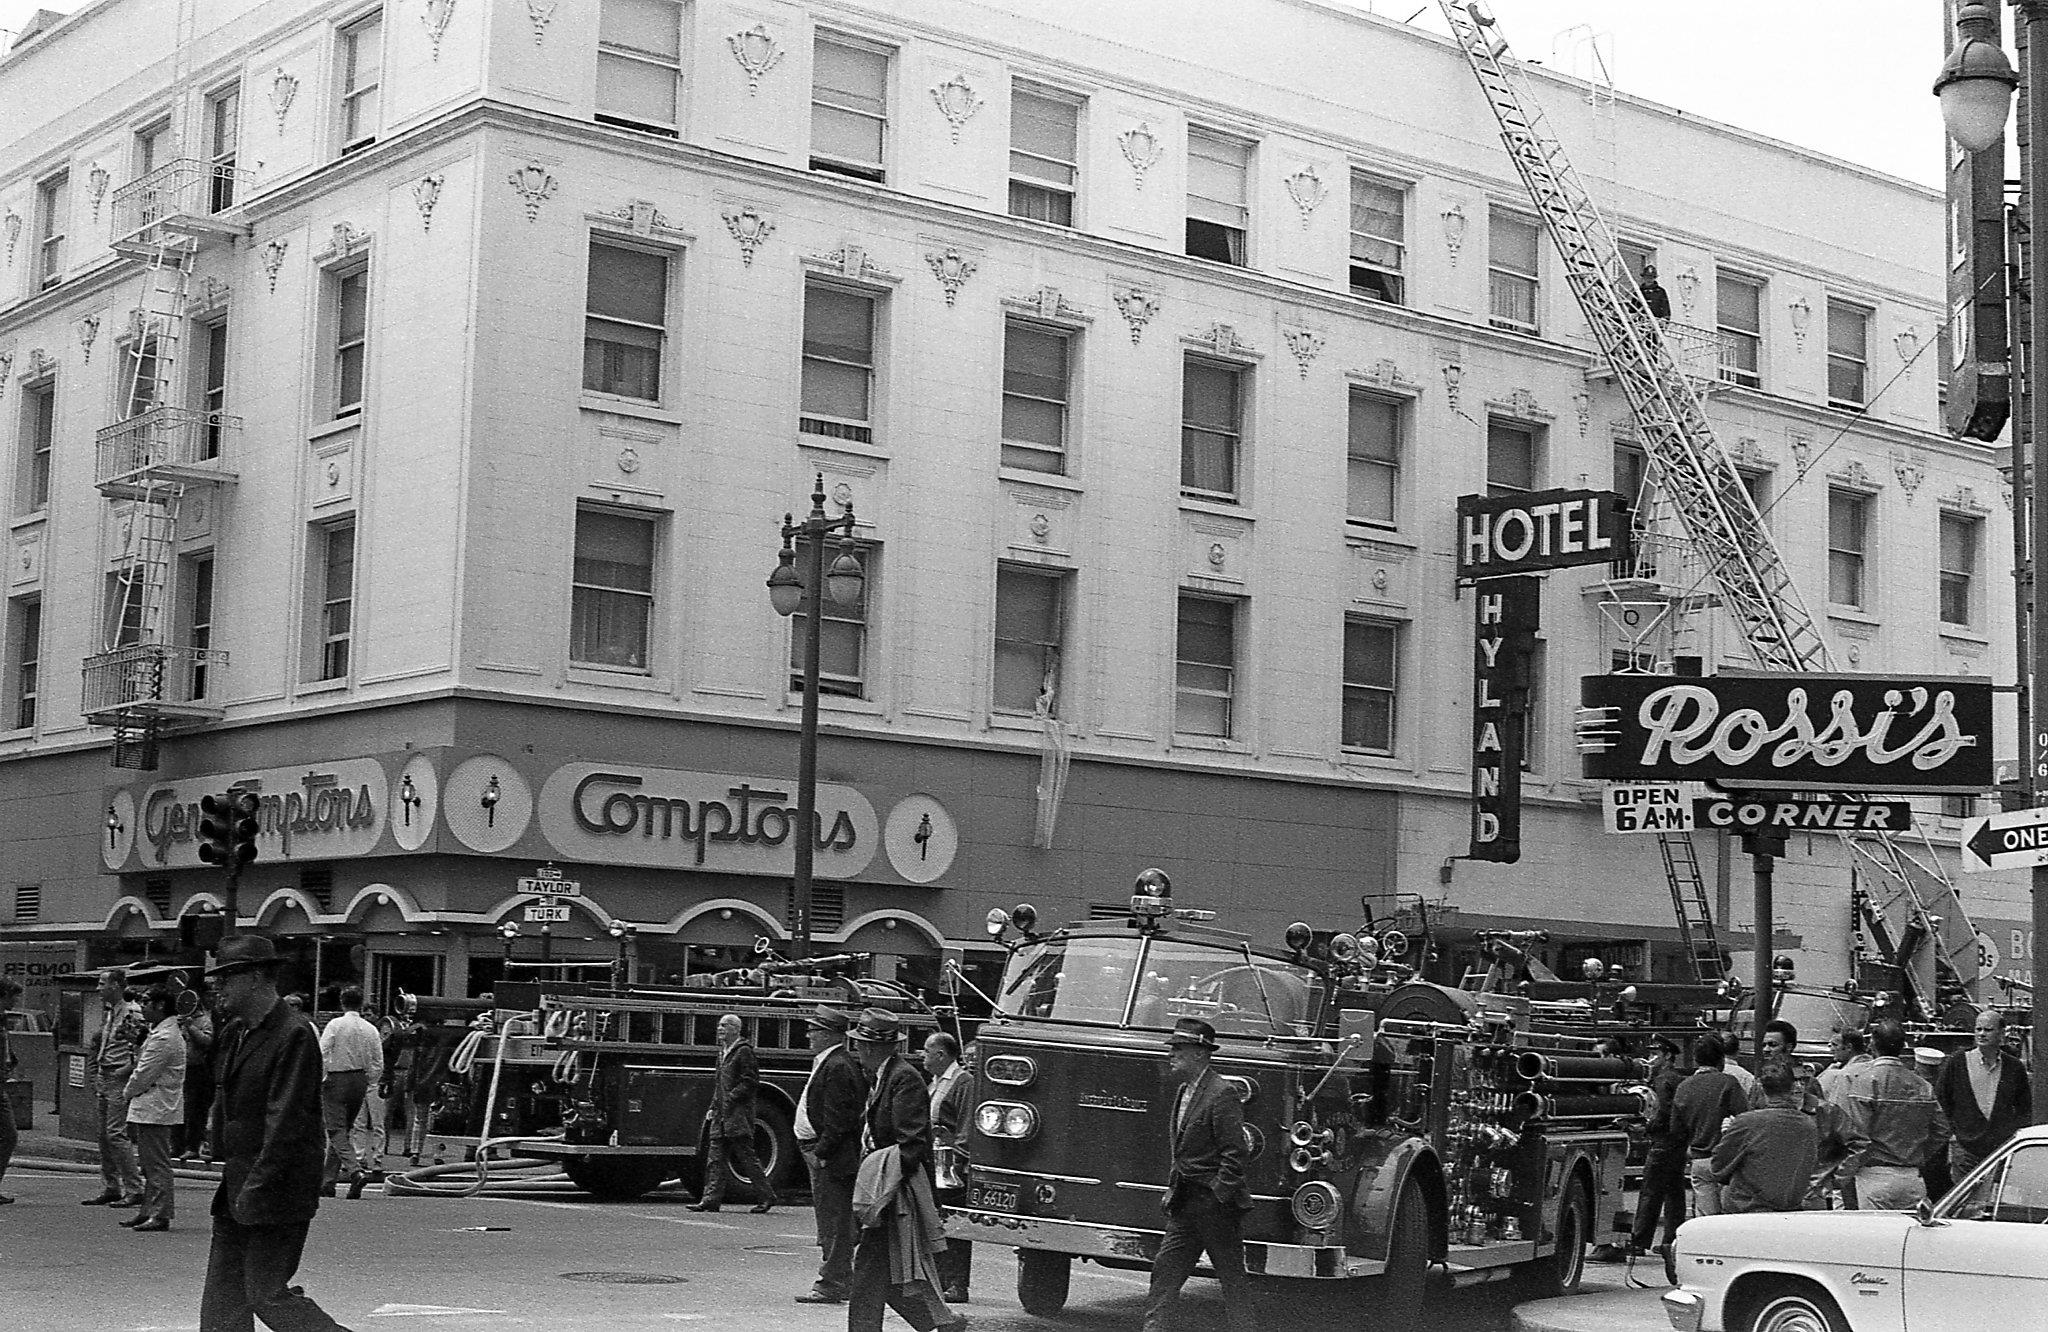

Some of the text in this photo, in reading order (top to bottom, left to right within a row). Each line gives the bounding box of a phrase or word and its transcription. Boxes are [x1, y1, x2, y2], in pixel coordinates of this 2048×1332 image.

[1464, 498, 1611, 566] HOTEL
[1477, 594, 1503, 843] HYLAND
[1638, 684, 1977, 771] Rossi's
[1614, 788, 1681, 806] OPEN
[227, 771, 376, 857] mptons
[573, 772, 857, 864] Comptons
[1616, 807, 1637, 831] 6
[1708, 801, 1891, 829] CORNER
[2003, 826, 2048, 850] ONE
[526, 880, 572, 894] TAYLOR
[531, 909, 562, 920] TURK
[983, 1190, 1016, 1208] 66120
[1850, 1272, 1889, 1285] Classic
